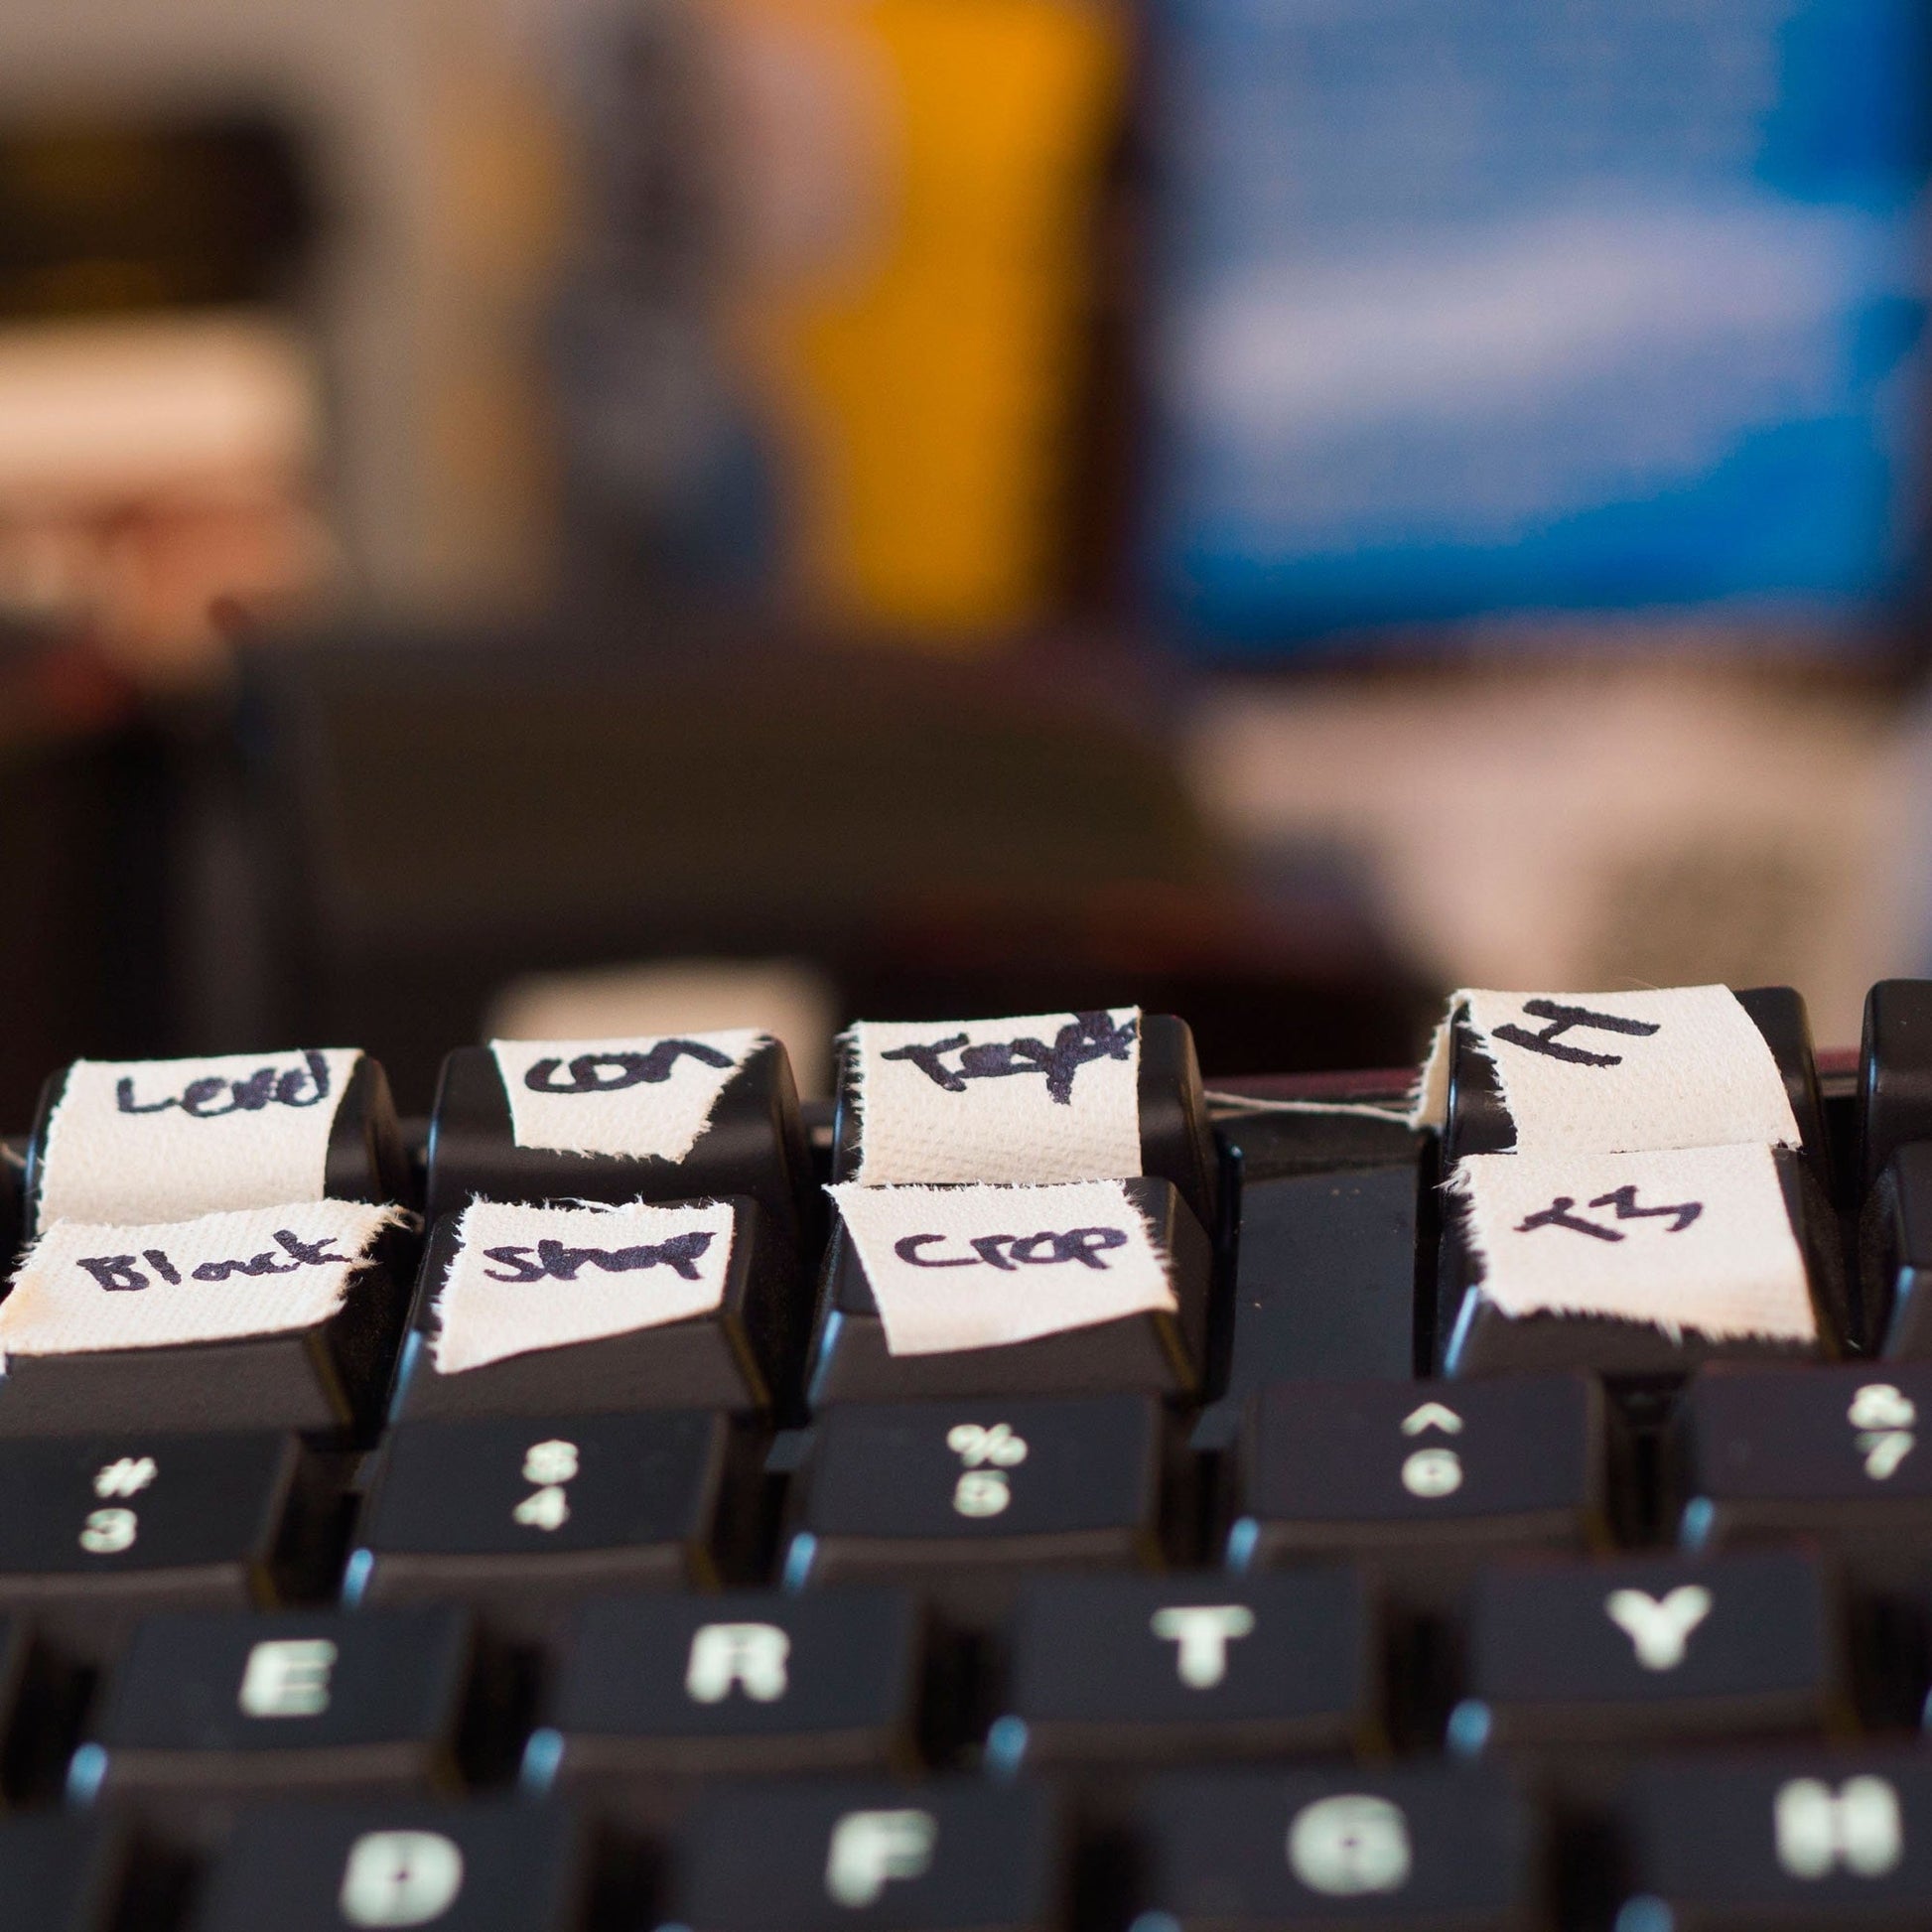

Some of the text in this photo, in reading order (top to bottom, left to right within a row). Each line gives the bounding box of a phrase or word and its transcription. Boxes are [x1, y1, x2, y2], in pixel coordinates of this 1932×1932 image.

[1859, 1430, 1914, 1478] 7
[79, 1507, 138, 1554] 3
[512, 1484, 571, 1531] 4
[684, 1621, 791, 1704] R
[1152, 1603, 1255, 1689] T
[1606, 1584, 1713, 1671] Y
[238, 1638, 337, 1718] E
[826, 1809, 932, 1907] F
[1773, 1775, 1903, 1877] H
[340, 1830, 464, 1928] D
